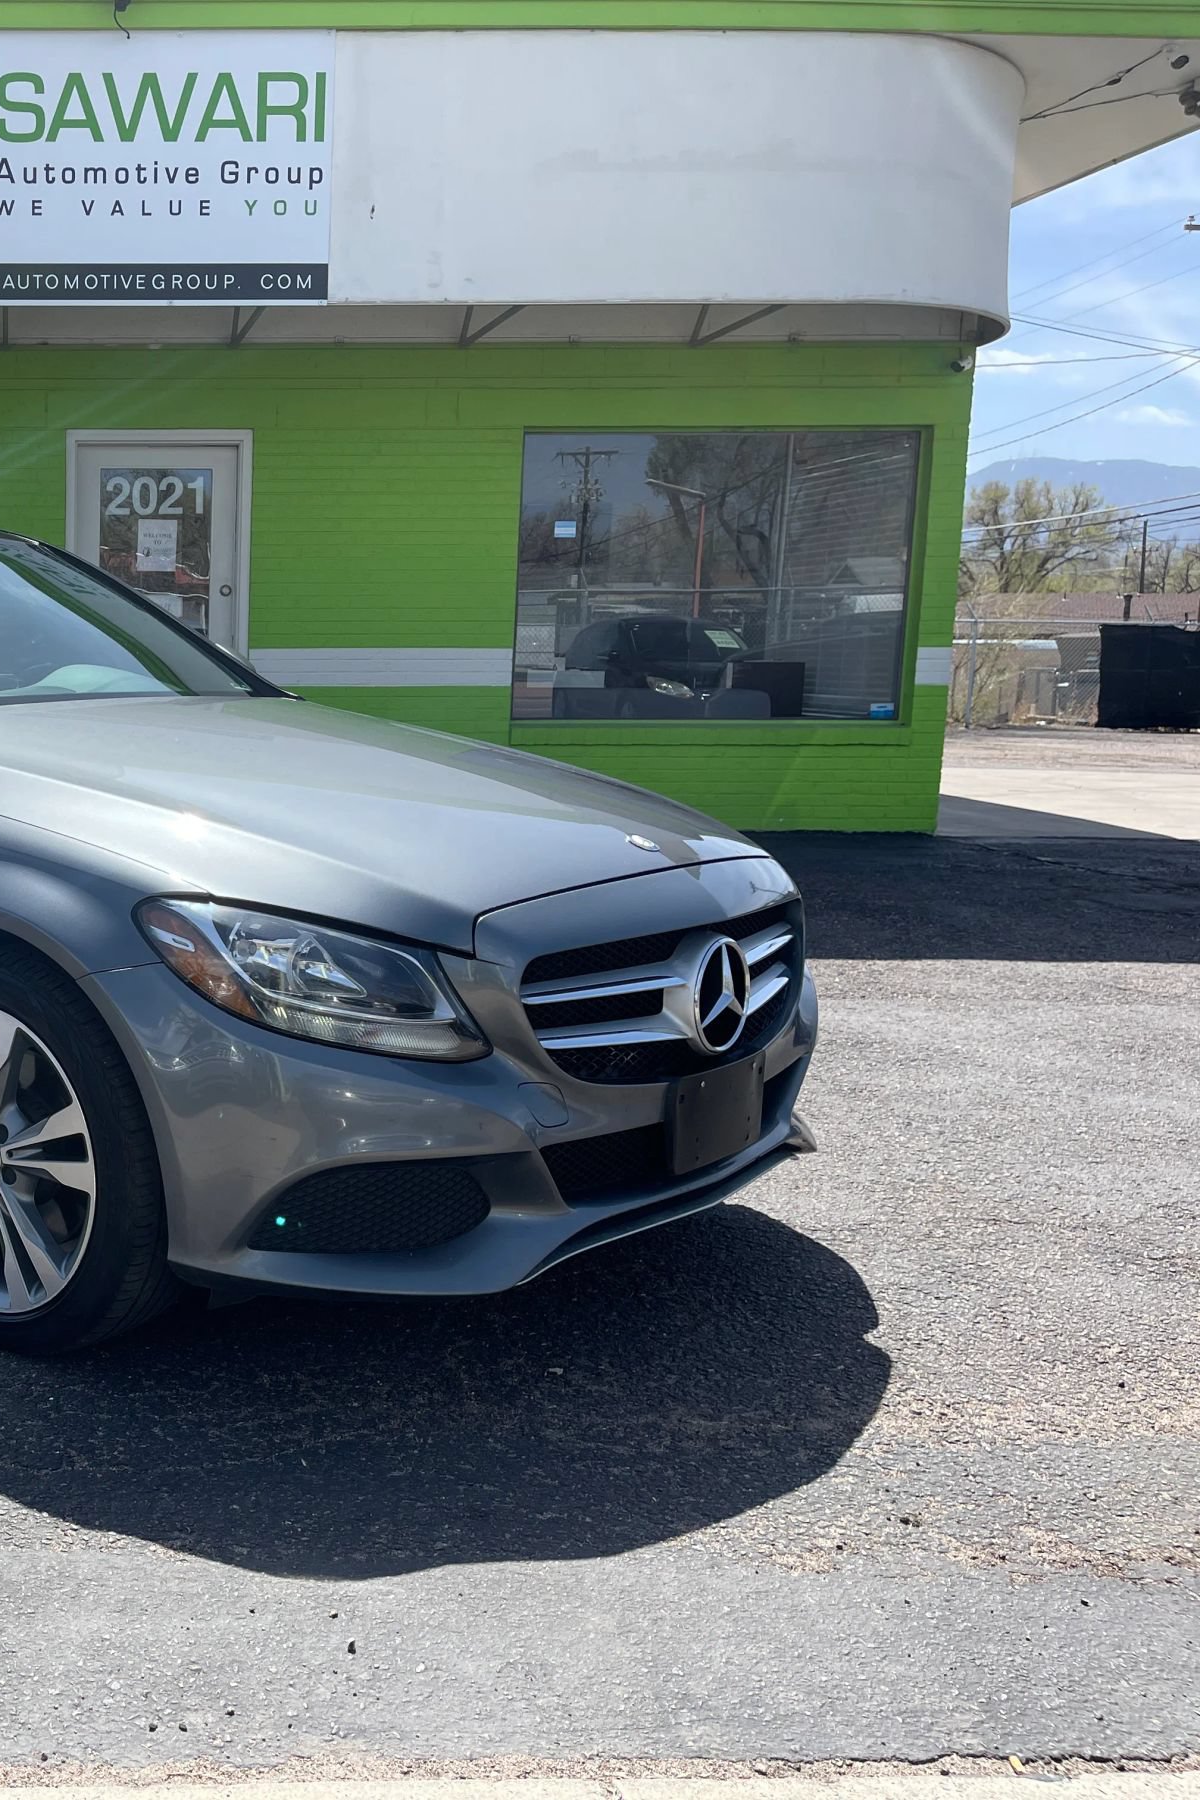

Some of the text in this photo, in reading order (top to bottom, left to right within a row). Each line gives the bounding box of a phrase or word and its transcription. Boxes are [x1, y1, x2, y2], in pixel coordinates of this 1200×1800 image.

[220, 160, 323, 190] Group
[81, 199, 211, 217] VALUE
[244, 199, 317, 217] YOU
[105, 476, 204, 516] 2021
